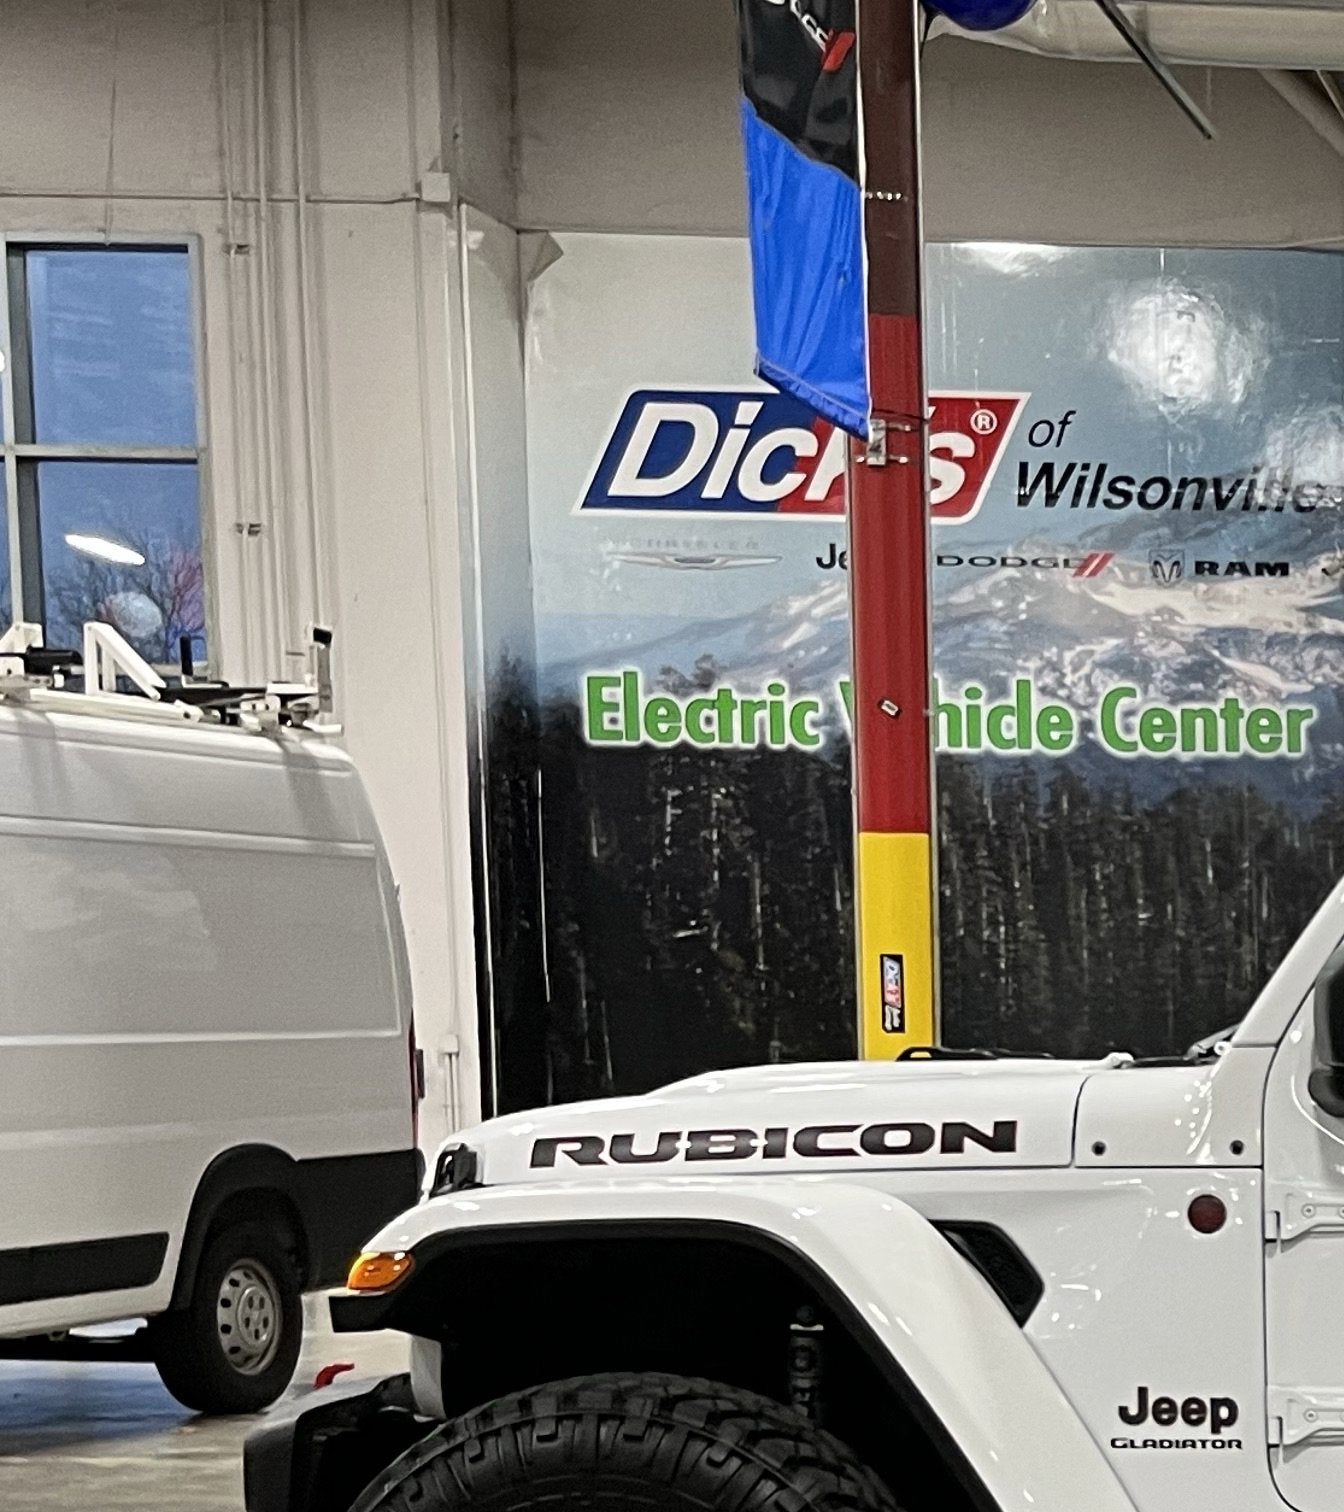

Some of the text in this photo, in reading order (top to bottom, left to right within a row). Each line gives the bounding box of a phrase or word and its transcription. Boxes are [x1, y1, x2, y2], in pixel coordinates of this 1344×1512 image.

[1028, 410, 1076, 448] of
[1195, 561, 1290, 576] RAM
[586, 671, 821, 746] Electric
[1101, 686, 1314, 754] Center
[529, 1119, 1018, 1169] RUBICON
[1118, 1386, 1239, 1435] Jeep
[1110, 1437, 1243, 1450] GLADIATOR
